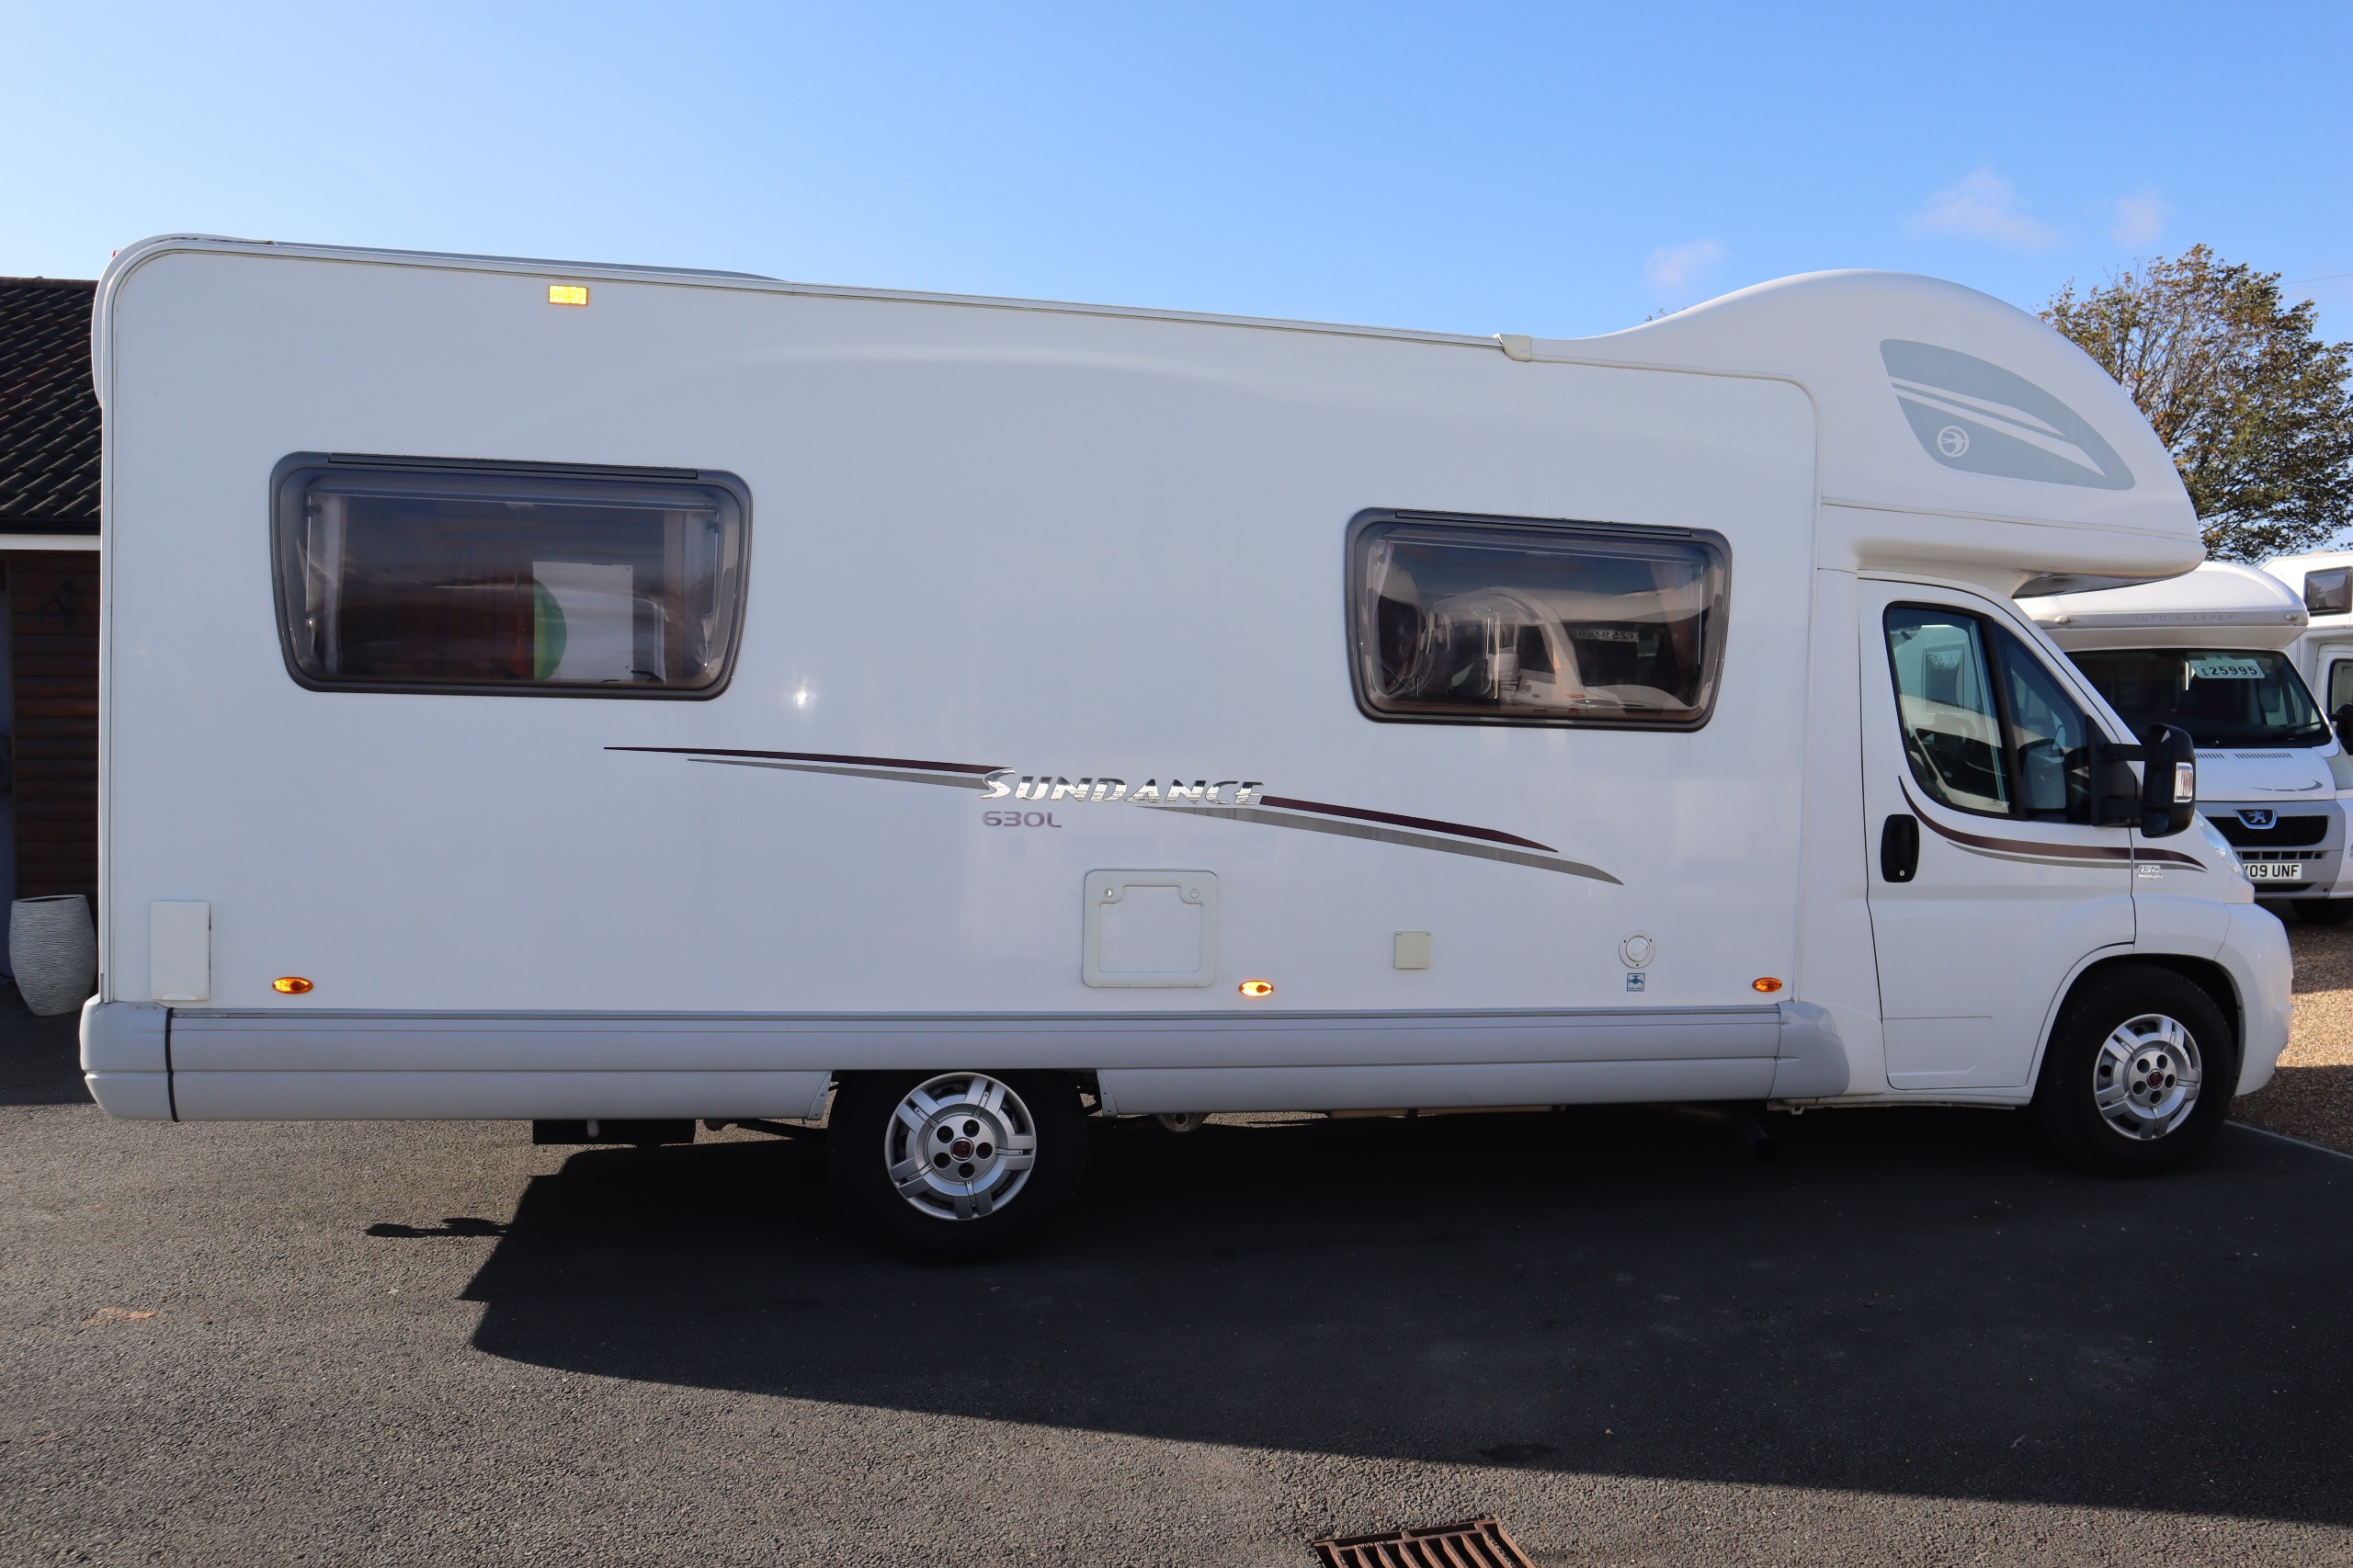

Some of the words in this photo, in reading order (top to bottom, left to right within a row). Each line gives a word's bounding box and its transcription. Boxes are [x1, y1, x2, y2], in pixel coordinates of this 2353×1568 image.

[979, 769, 1264, 804] SUNDANCE
[982, 811, 1062, 828] 630L
[2245, 865, 2268, 878] 09
[2272, 865, 2300, 878] UNF
